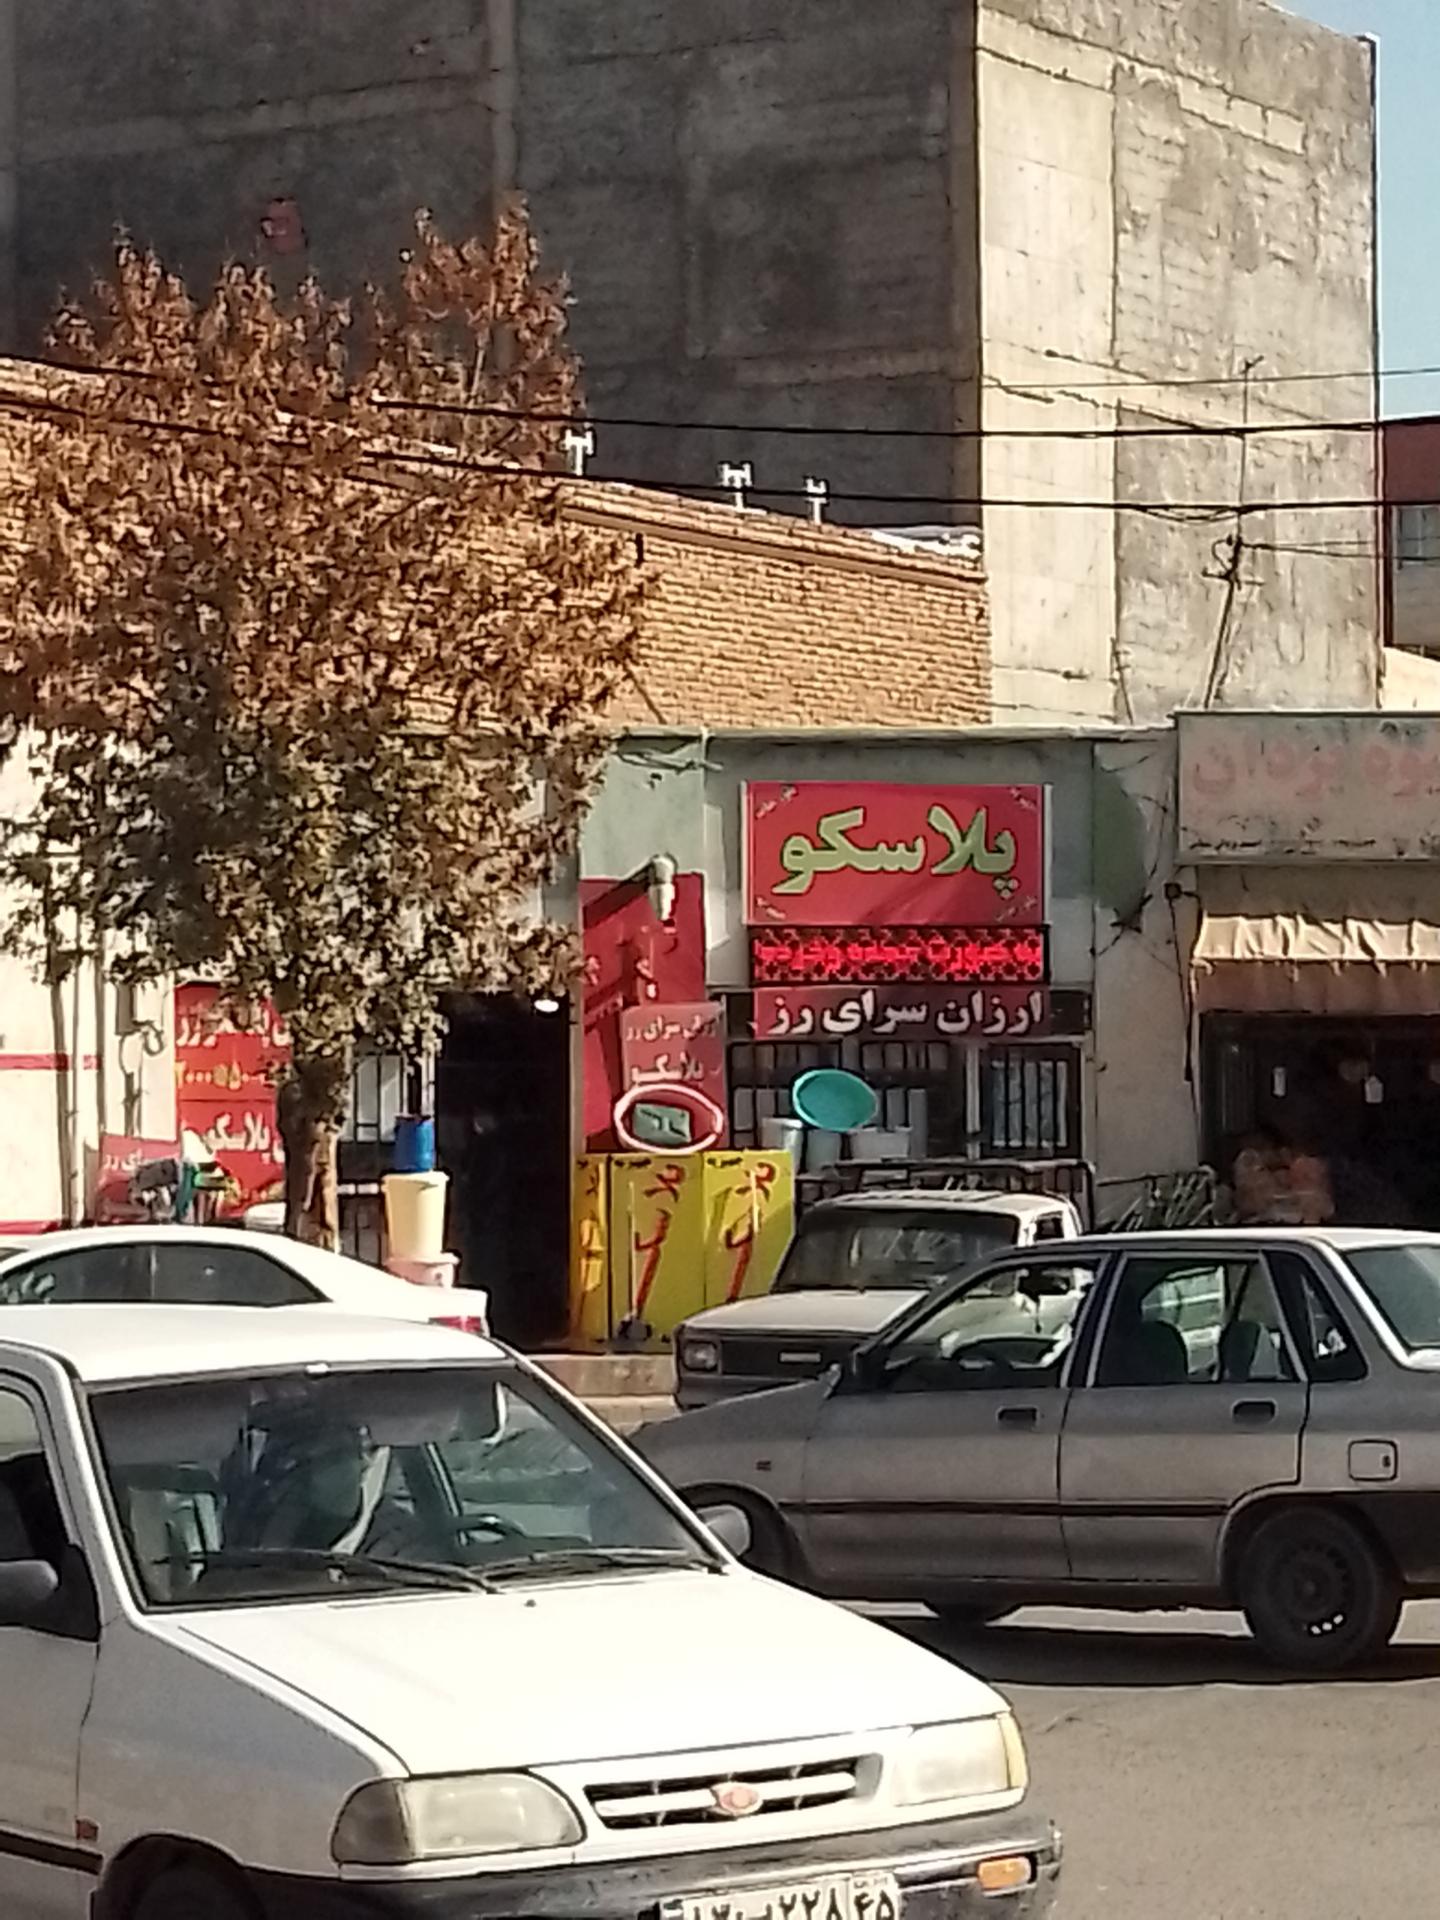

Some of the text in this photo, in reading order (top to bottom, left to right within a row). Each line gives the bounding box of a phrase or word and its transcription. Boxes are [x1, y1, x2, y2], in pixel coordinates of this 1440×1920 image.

[771, 804, 1021, 898] پلاسکو
[766, 988, 1042, 1035] ارزان سرای رز
